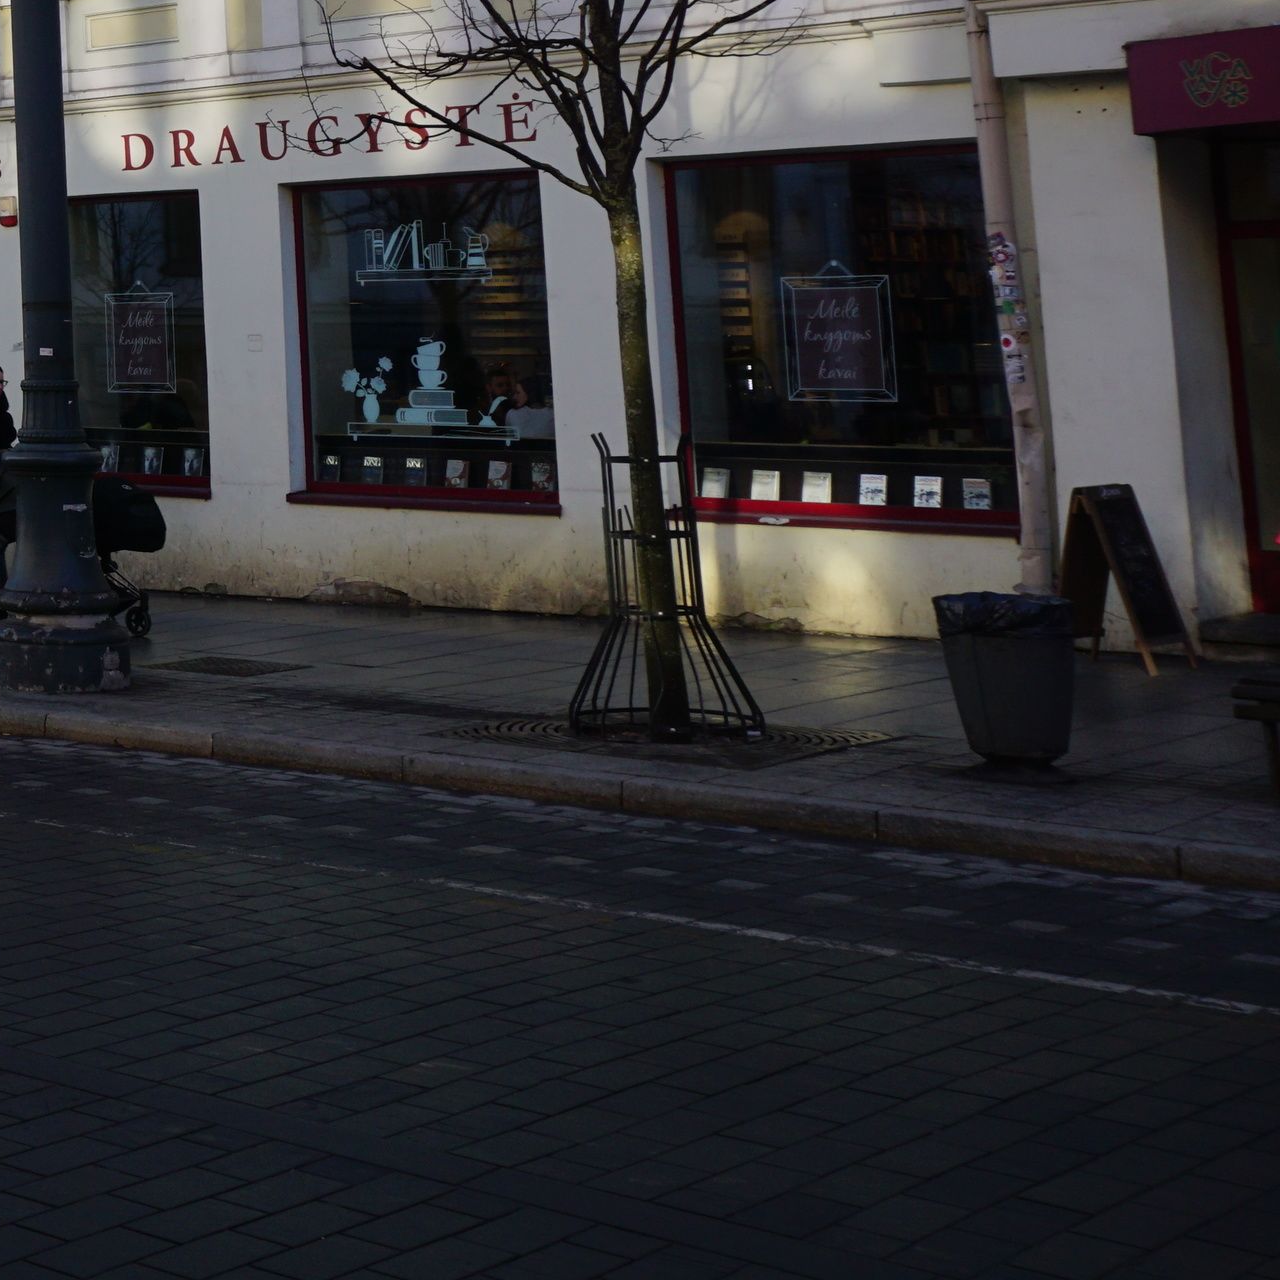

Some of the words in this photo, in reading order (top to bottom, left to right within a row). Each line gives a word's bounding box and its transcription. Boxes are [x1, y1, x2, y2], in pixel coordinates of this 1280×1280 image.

[122, 92, 539, 171] DRAUGYSTĖ
[119, 329, 162, 355] knygoms
[803, 321, 873, 353] knygoms
[127, 359, 152, 376] kavai
[818, 359, 857, 380] kavai
